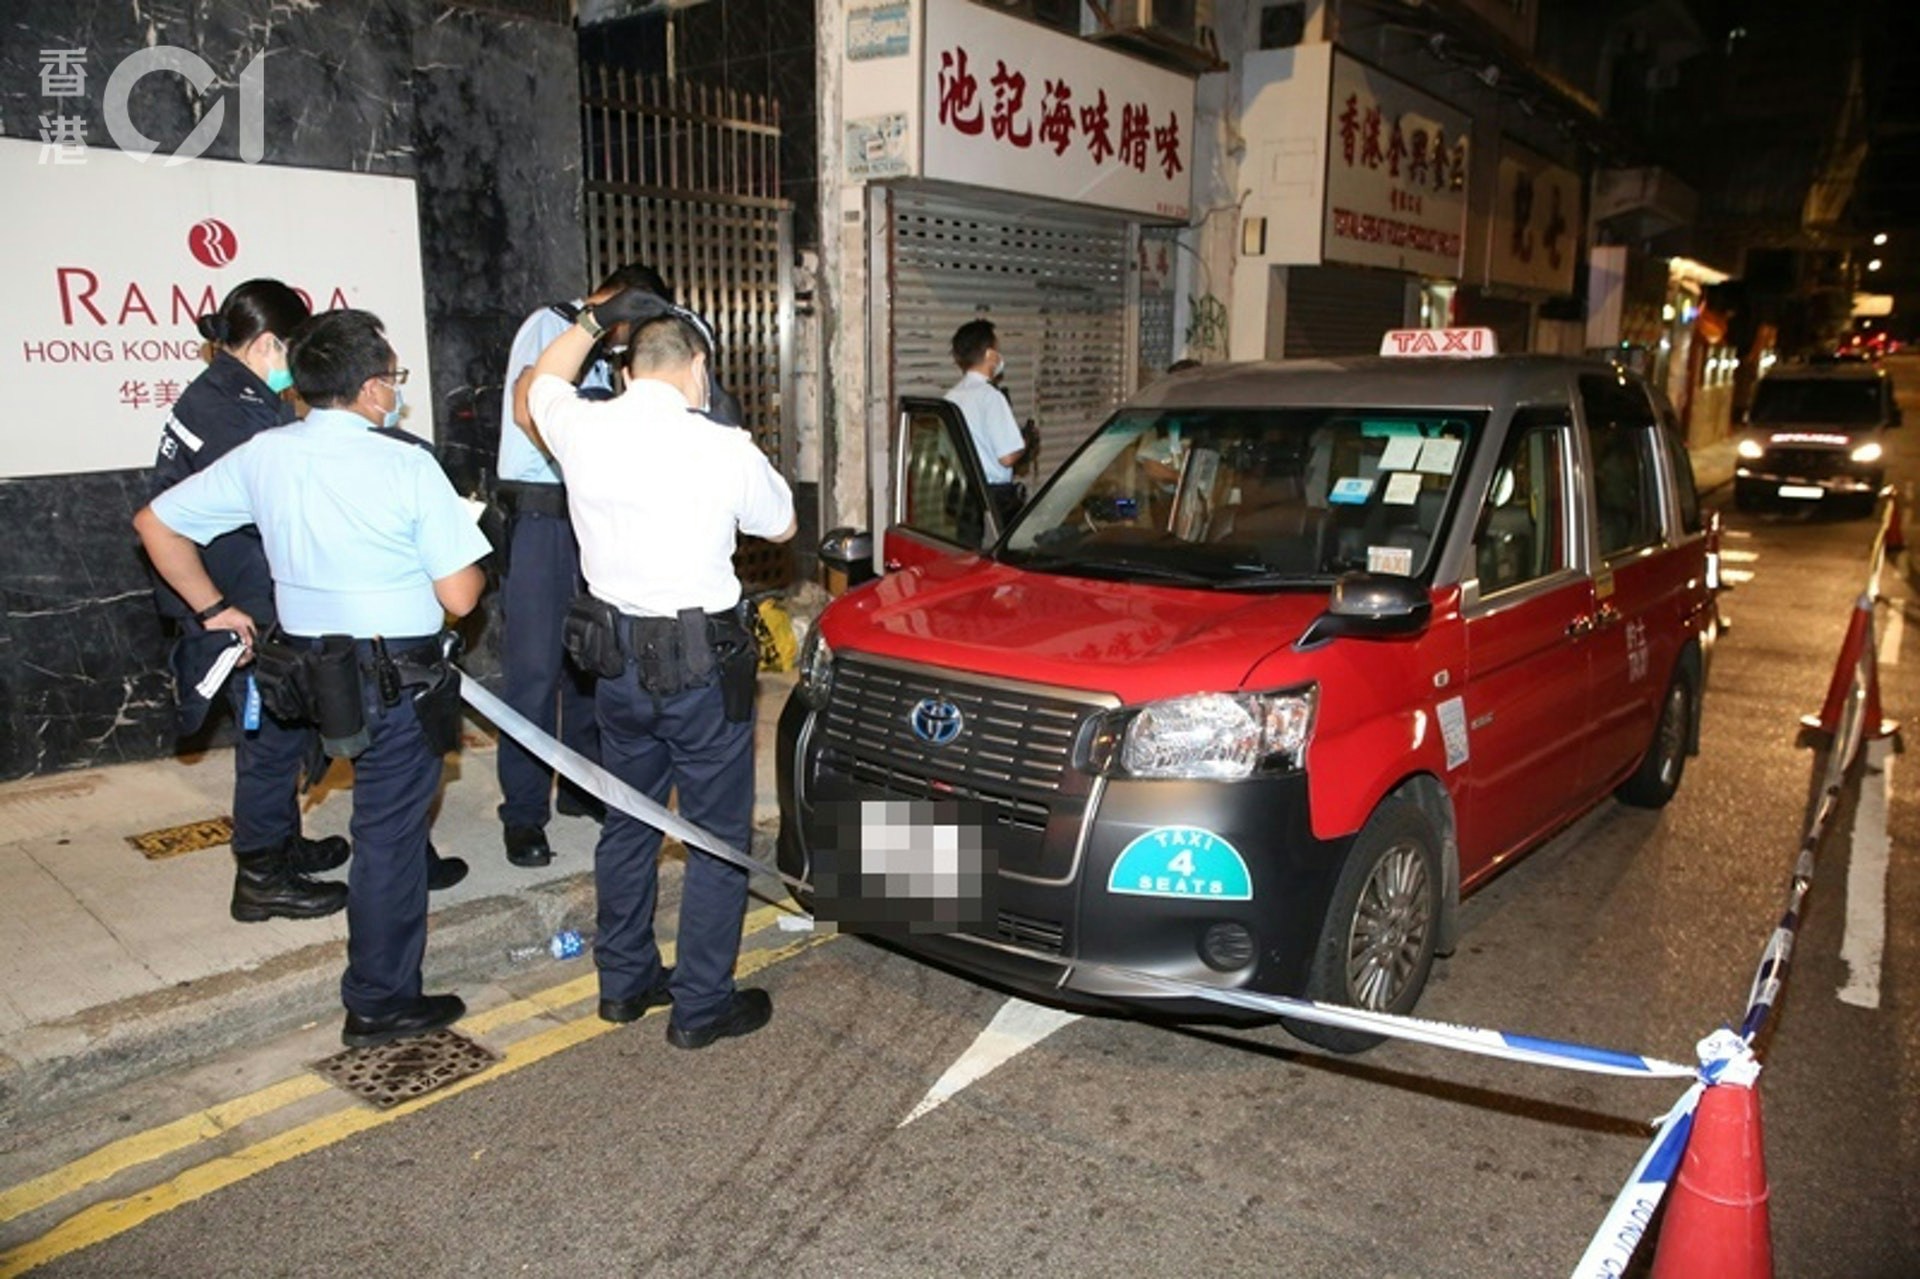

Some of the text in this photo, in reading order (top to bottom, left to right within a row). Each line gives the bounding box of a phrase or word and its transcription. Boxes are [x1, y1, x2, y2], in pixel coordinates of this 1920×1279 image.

[938, 46, 1183, 180] 池記海味腊味
[24, 340, 201, 363] HONG KONG
[1391, 330, 1483, 353] TAXI
[1373, 554, 1409, 575] TAXI
[1155, 830, 1214, 851] TAXI
[1167, 849, 1196, 877] 4
[1138, 875, 1223, 894] SEATS
